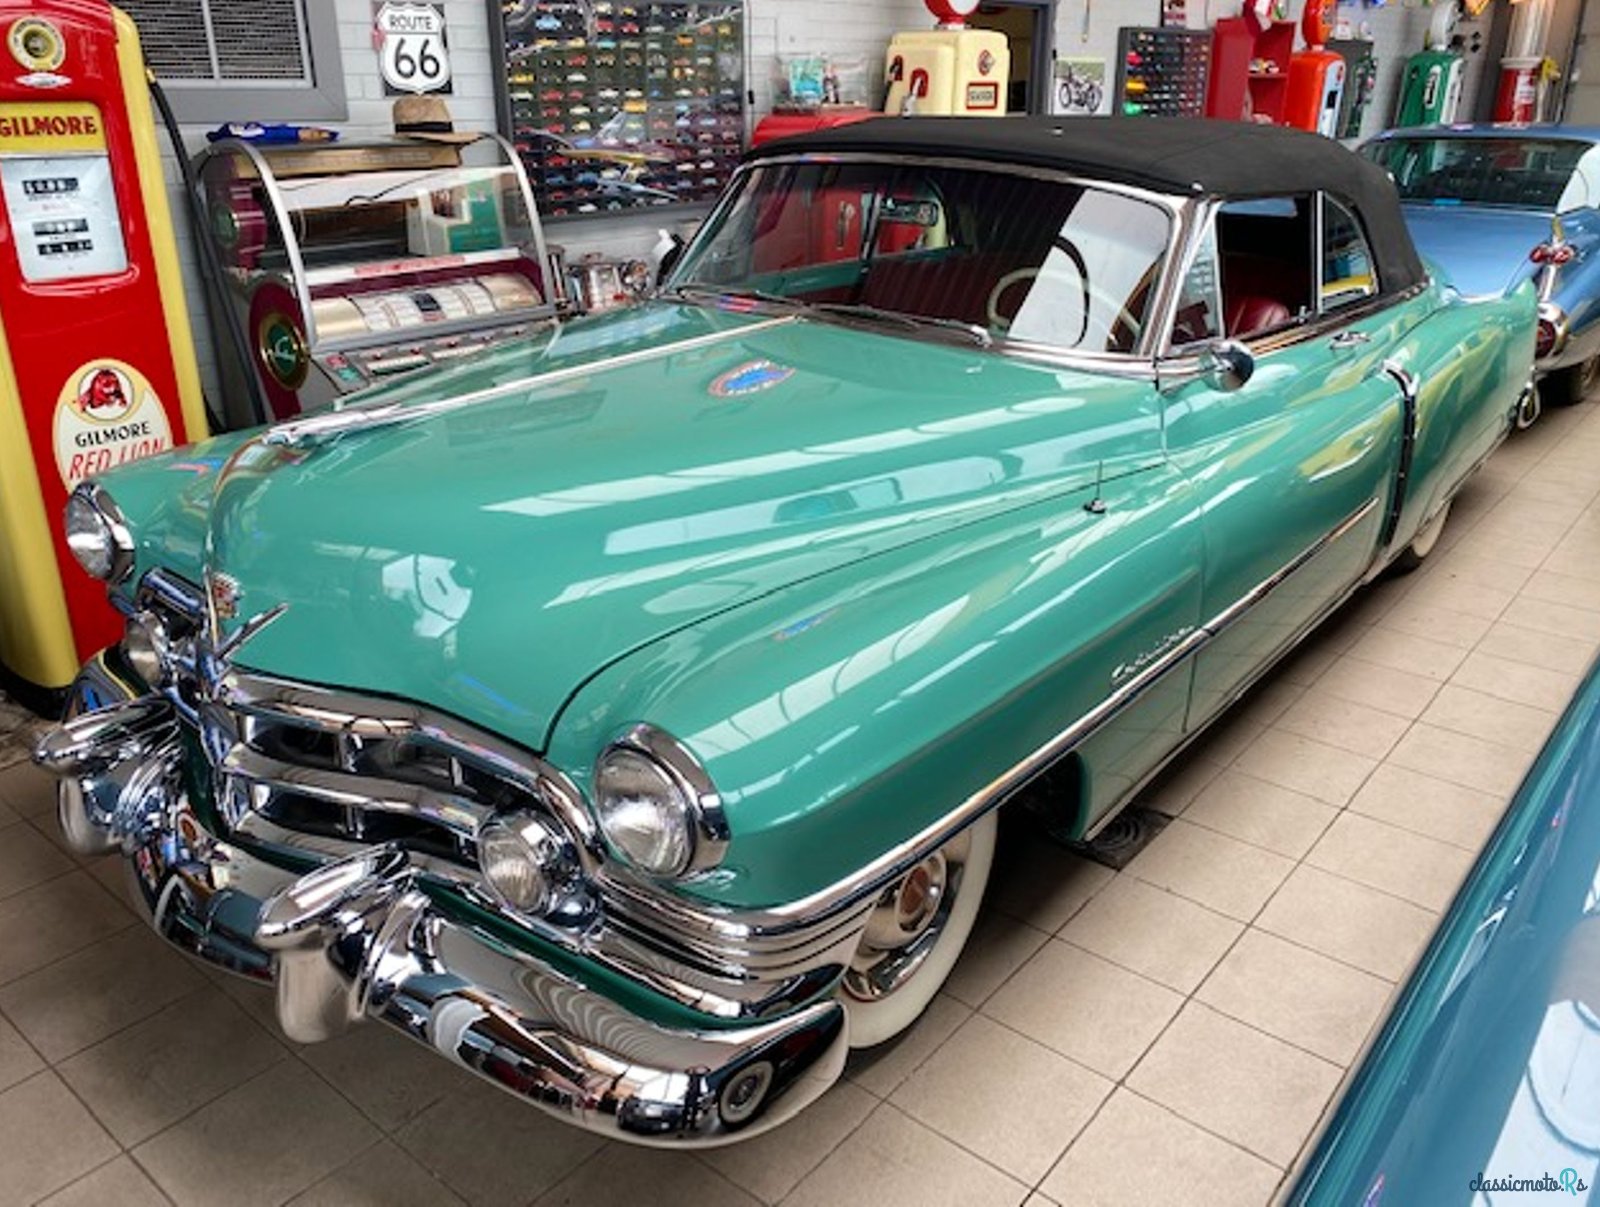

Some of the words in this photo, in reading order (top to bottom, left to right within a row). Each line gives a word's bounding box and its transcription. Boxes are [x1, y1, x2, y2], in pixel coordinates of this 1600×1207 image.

[389, 14, 432, 30] ROUTE
[395, 37, 439, 78] 66
[0, 116, 97, 137] GILMORE
[75, 421, 151, 447] GILMORE
